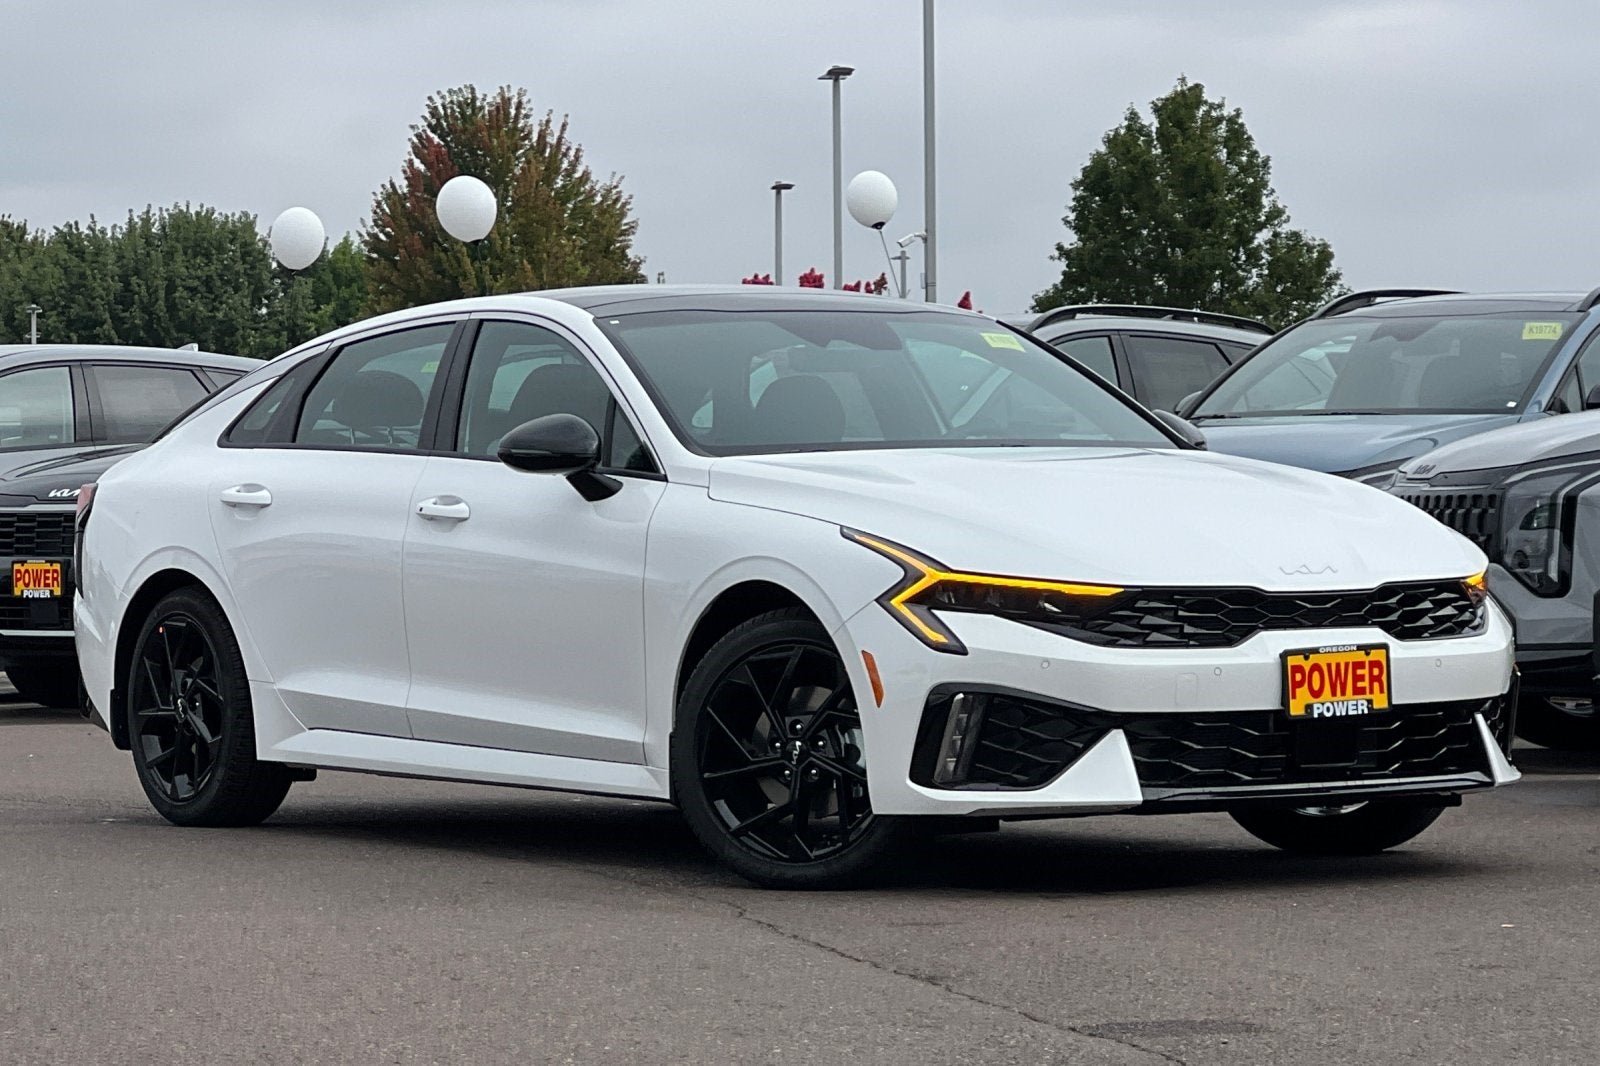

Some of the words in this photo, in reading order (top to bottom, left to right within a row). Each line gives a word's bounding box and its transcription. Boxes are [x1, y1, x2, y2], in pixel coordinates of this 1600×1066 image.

[14, 568, 60, 588] POWER
[23, 589, 51, 598] POWER
[1319, 645, 1358, 654] OREGON
[1290, 659, 1385, 700] POWER
[1313, 699, 1369, 718] POWER
